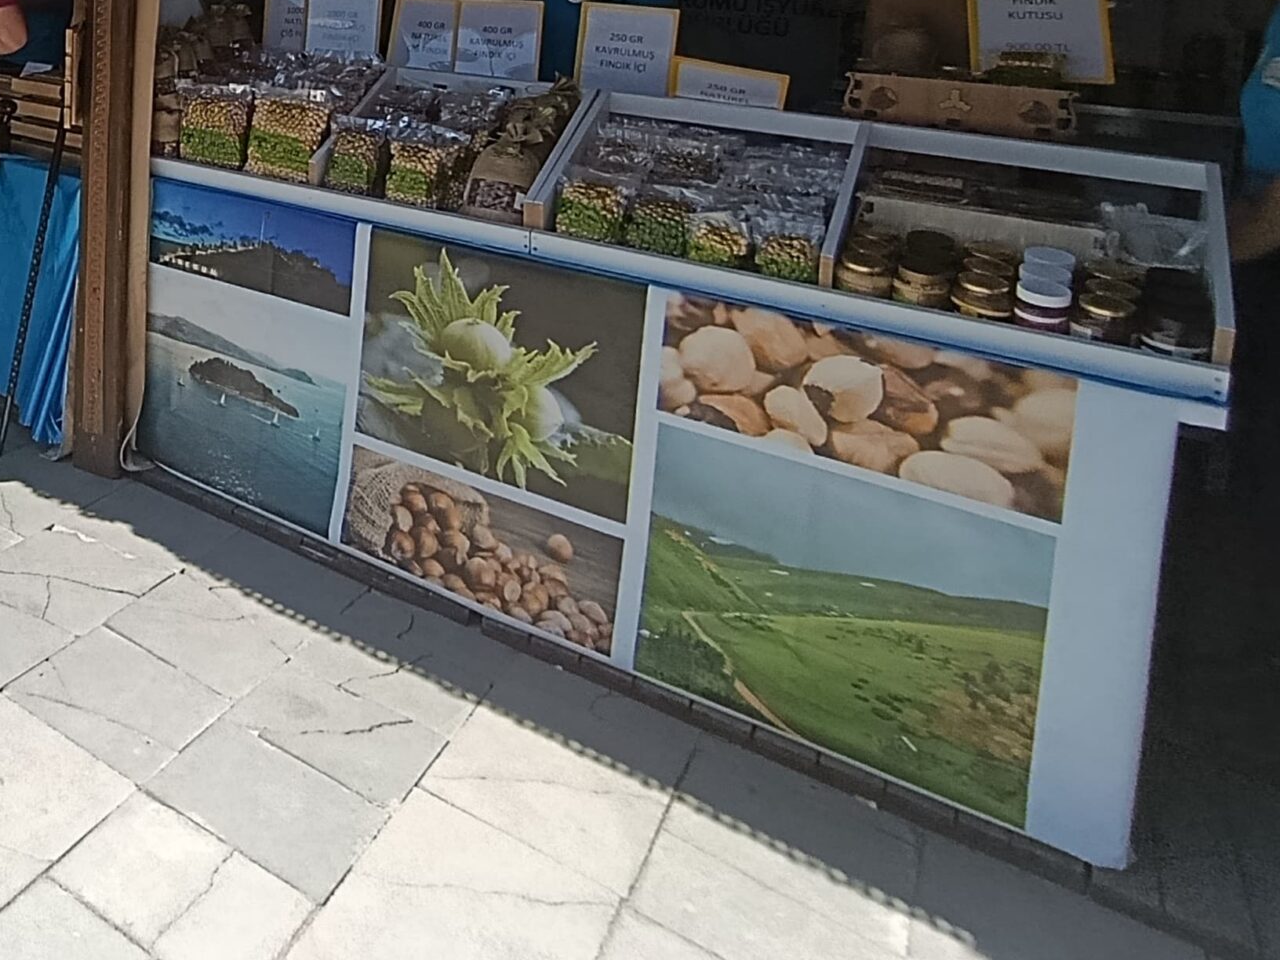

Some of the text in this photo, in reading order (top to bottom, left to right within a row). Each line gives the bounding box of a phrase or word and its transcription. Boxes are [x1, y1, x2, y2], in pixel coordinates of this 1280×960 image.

[1007, 10, 1064, 21] KUTUSU
[417, 20, 446, 30] 400 GR
[482, 25, 513, 35] 400 GR
[609, 32, 644, 45] 250 GR
[594, 45, 656, 61] KAVRULMUŞ
[599, 59, 632, 72] FINDIK
[730, 85, 747, 95] GR
